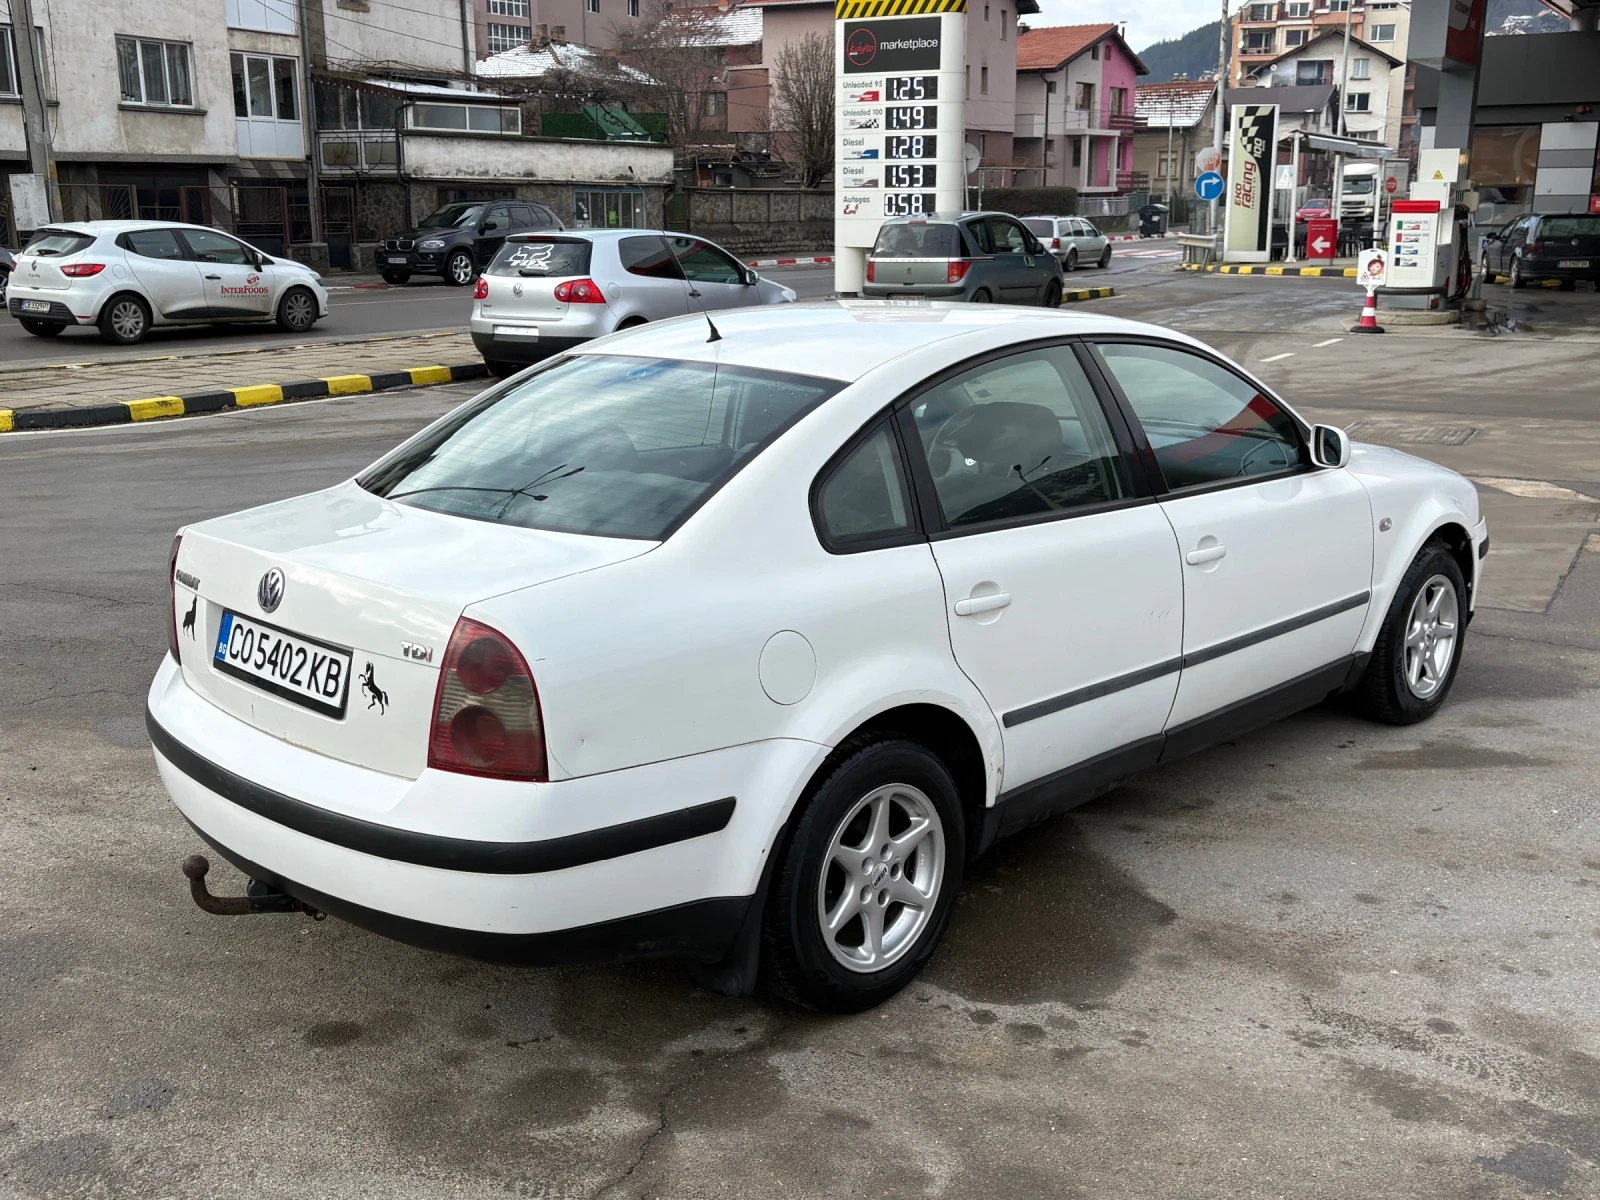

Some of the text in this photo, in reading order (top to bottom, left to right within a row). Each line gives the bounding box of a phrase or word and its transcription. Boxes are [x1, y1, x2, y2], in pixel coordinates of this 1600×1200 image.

[880, 38, 938, 50] marketplace
[843, 80, 883, 89] Unleaded 95
[893, 77, 924, 100] 1.25
[843, 108, 883, 117] Unleaded 100
[893, 106, 924, 129] 1.49
[843, 137, 864, 146] Diesel
[892, 136, 923, 158] 1.28
[1253, 137, 1262, 158] 100
[843, 167, 864, 175] Diesel
[1241, 160, 1257, 209] racing
[843, 196, 870, 204] Autogas
[1234, 183, 1242, 207] EKO
[885, 194, 923, 215] 0.58
[218, 642, 227, 655] BG
